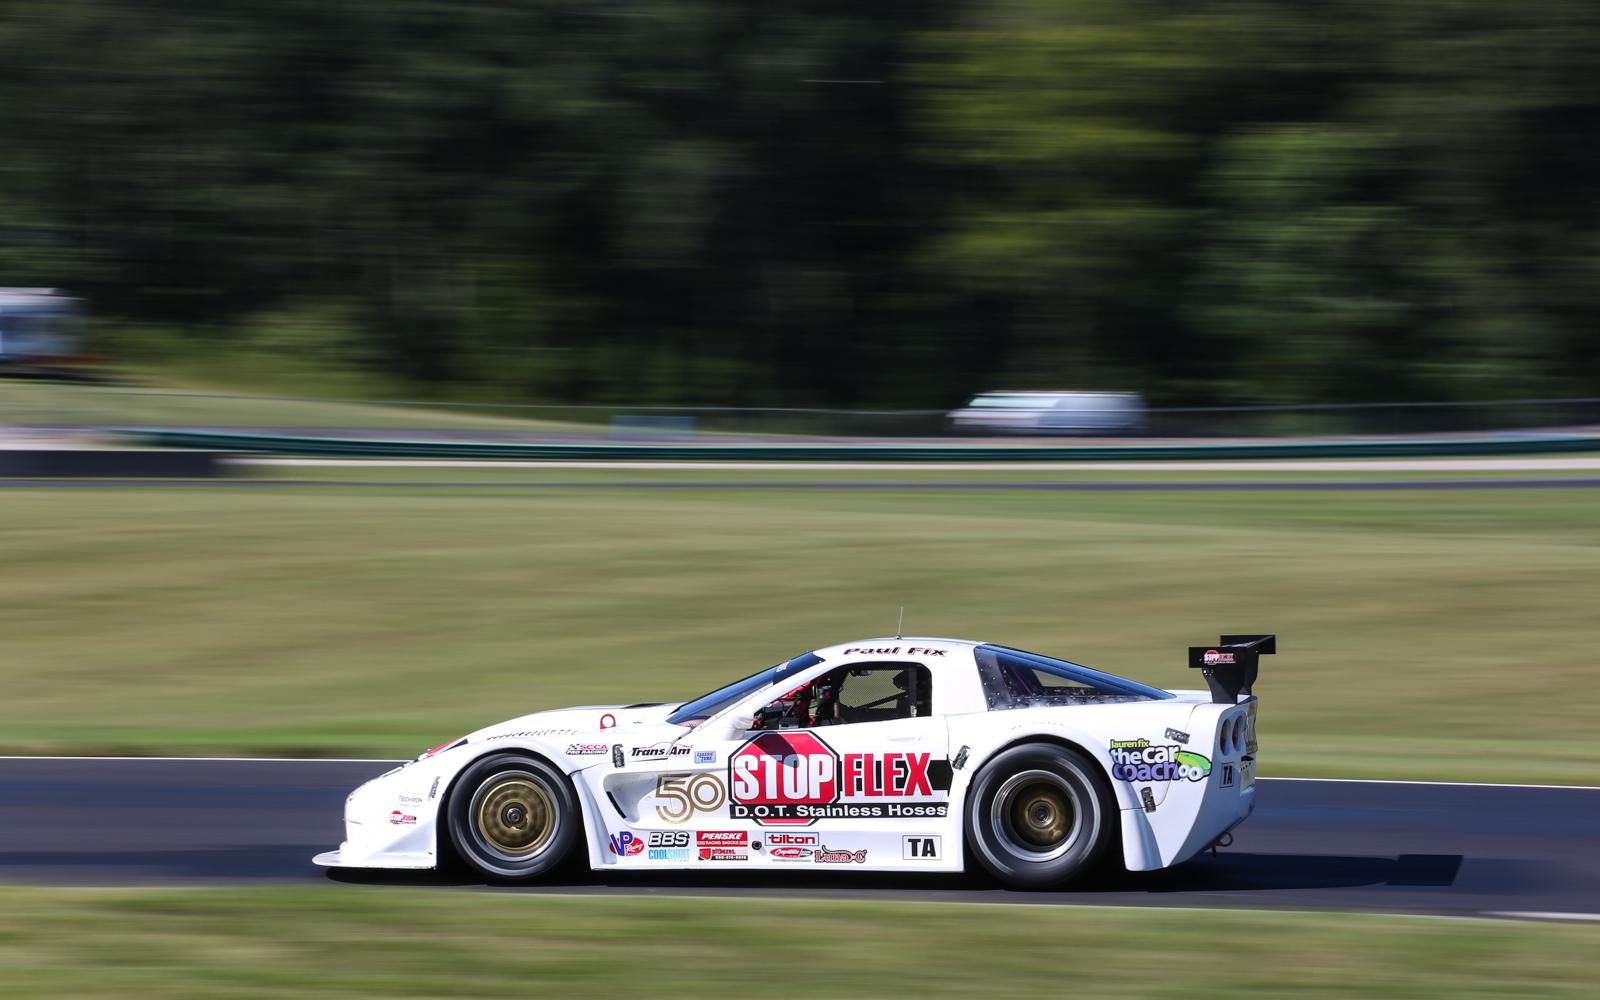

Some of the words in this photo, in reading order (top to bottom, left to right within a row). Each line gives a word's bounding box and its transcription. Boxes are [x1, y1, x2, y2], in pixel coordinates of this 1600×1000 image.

[843, 647, 901, 655] Paul
[907, 647, 949, 657] Fix
[631, 747, 665, 756] Trans
[668, 746, 691, 755] Am
[1111, 740, 1136, 748] lauren
[1137, 739, 1149, 748] fix
[1110, 748, 1142, 764] the
[1141, 746, 1180, 764] car
[734, 754, 835, 800] STOP
[843, 752, 932, 797] FLEX
[1113, 761, 1179, 780] coach
[1223, 765, 1233, 785] TA
[656, 773, 726, 824] 50
[735, 805, 790, 817] D.O.T.
[796, 805, 882, 816] Stainless
[888, 804, 947, 816] Hoses
[610, 831, 633, 857] VP
[648, 831, 689, 847] BBS
[768, 834, 815, 844] tilton
[907, 838, 937, 857] TA
[648, 849, 690, 860] COOLSHIRT
